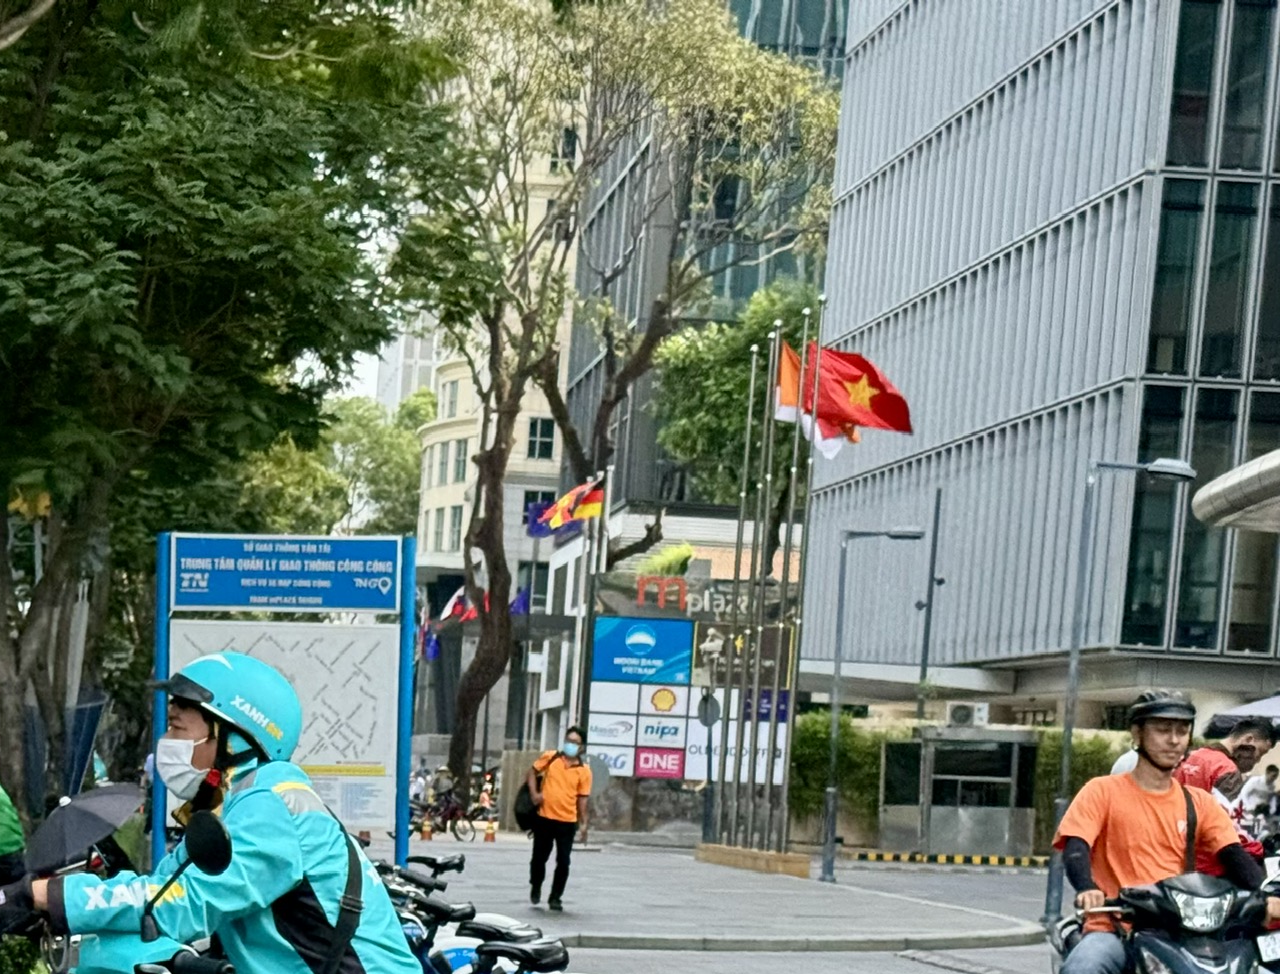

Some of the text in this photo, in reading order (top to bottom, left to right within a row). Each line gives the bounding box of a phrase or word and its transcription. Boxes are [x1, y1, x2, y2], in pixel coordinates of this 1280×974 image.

[181, 558, 212, 571] TRUNG
[213, 556, 235, 571] TÂM
[236, 556, 264, 571] QUẢN
[279, 559, 302, 572] GIAO
[303, 559, 336, 573] THÔNG
[230, 694, 270, 728] XANH
[644, 721, 680, 740] nipa
[639, 752, 680, 770] ONE
